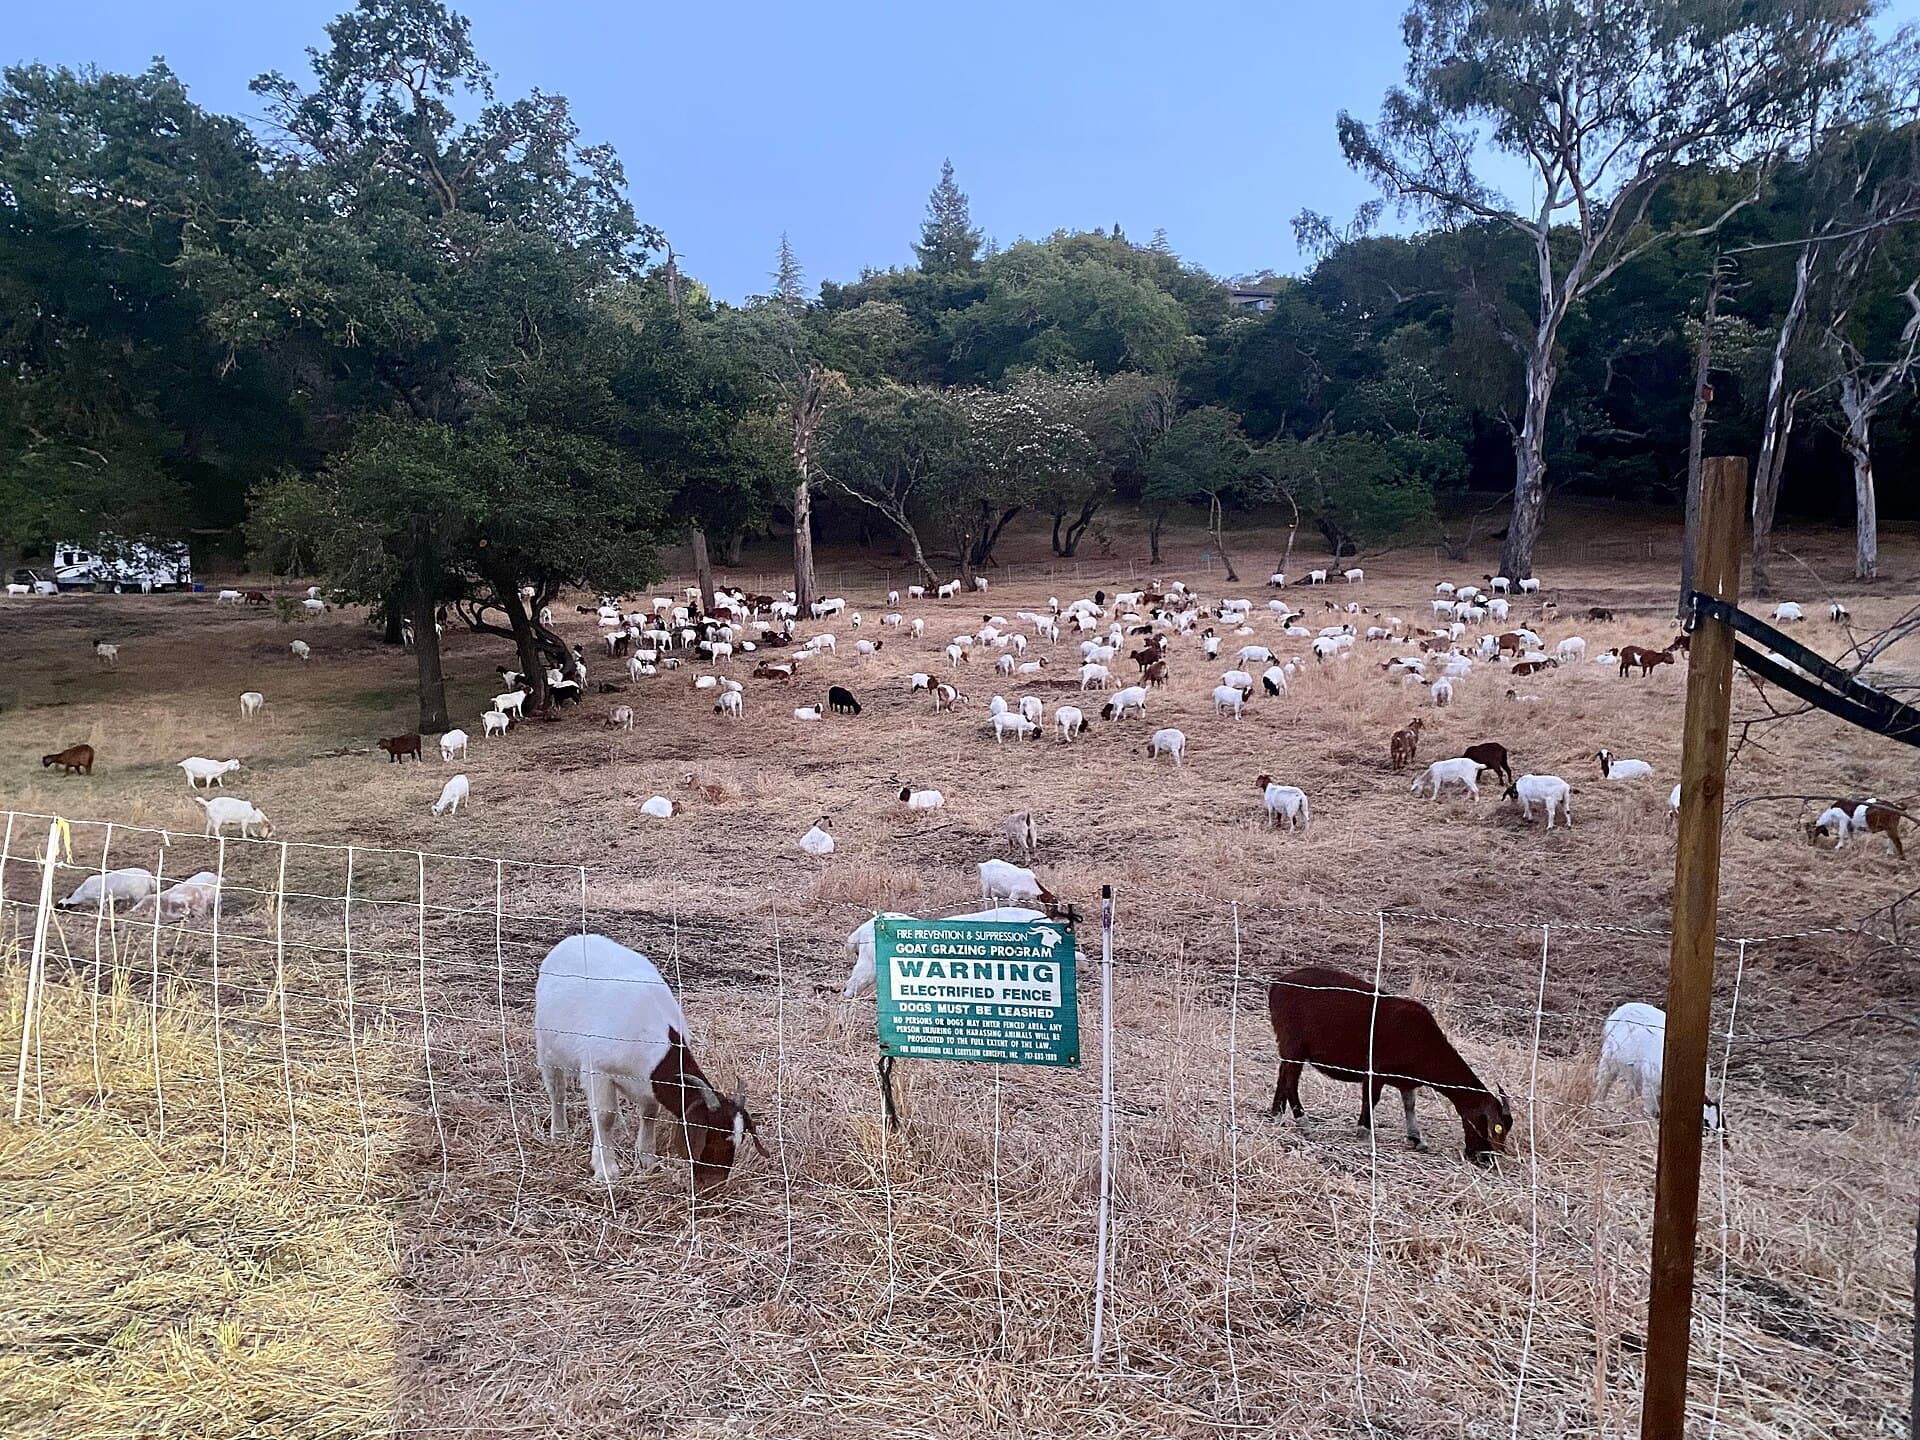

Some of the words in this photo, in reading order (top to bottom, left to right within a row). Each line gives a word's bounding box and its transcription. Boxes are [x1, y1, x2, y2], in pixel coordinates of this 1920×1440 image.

[897, 930, 912, 939] FIRE
[915, 930, 964, 940] PREVENTION
[976, 932, 1028, 941] SUPPRESSION
[896, 944, 927, 954] GOAT
[931, 944, 986, 955] GRAZING
[991, 946, 1052, 957] PROGRAM
[897, 961, 1053, 982] WARNING
[901, 985, 994, 998] ELECTRIFIED
[1003, 989, 1051, 1001] FENCE
[900, 1002, 931, 1012] DOGS
[938, 1004, 969, 1014] MUST
[976, 1006, 992, 1015] BE
[998, 1006, 1054, 1018] LEASHED
[966, 1029, 1001, 1037] HARASSING
